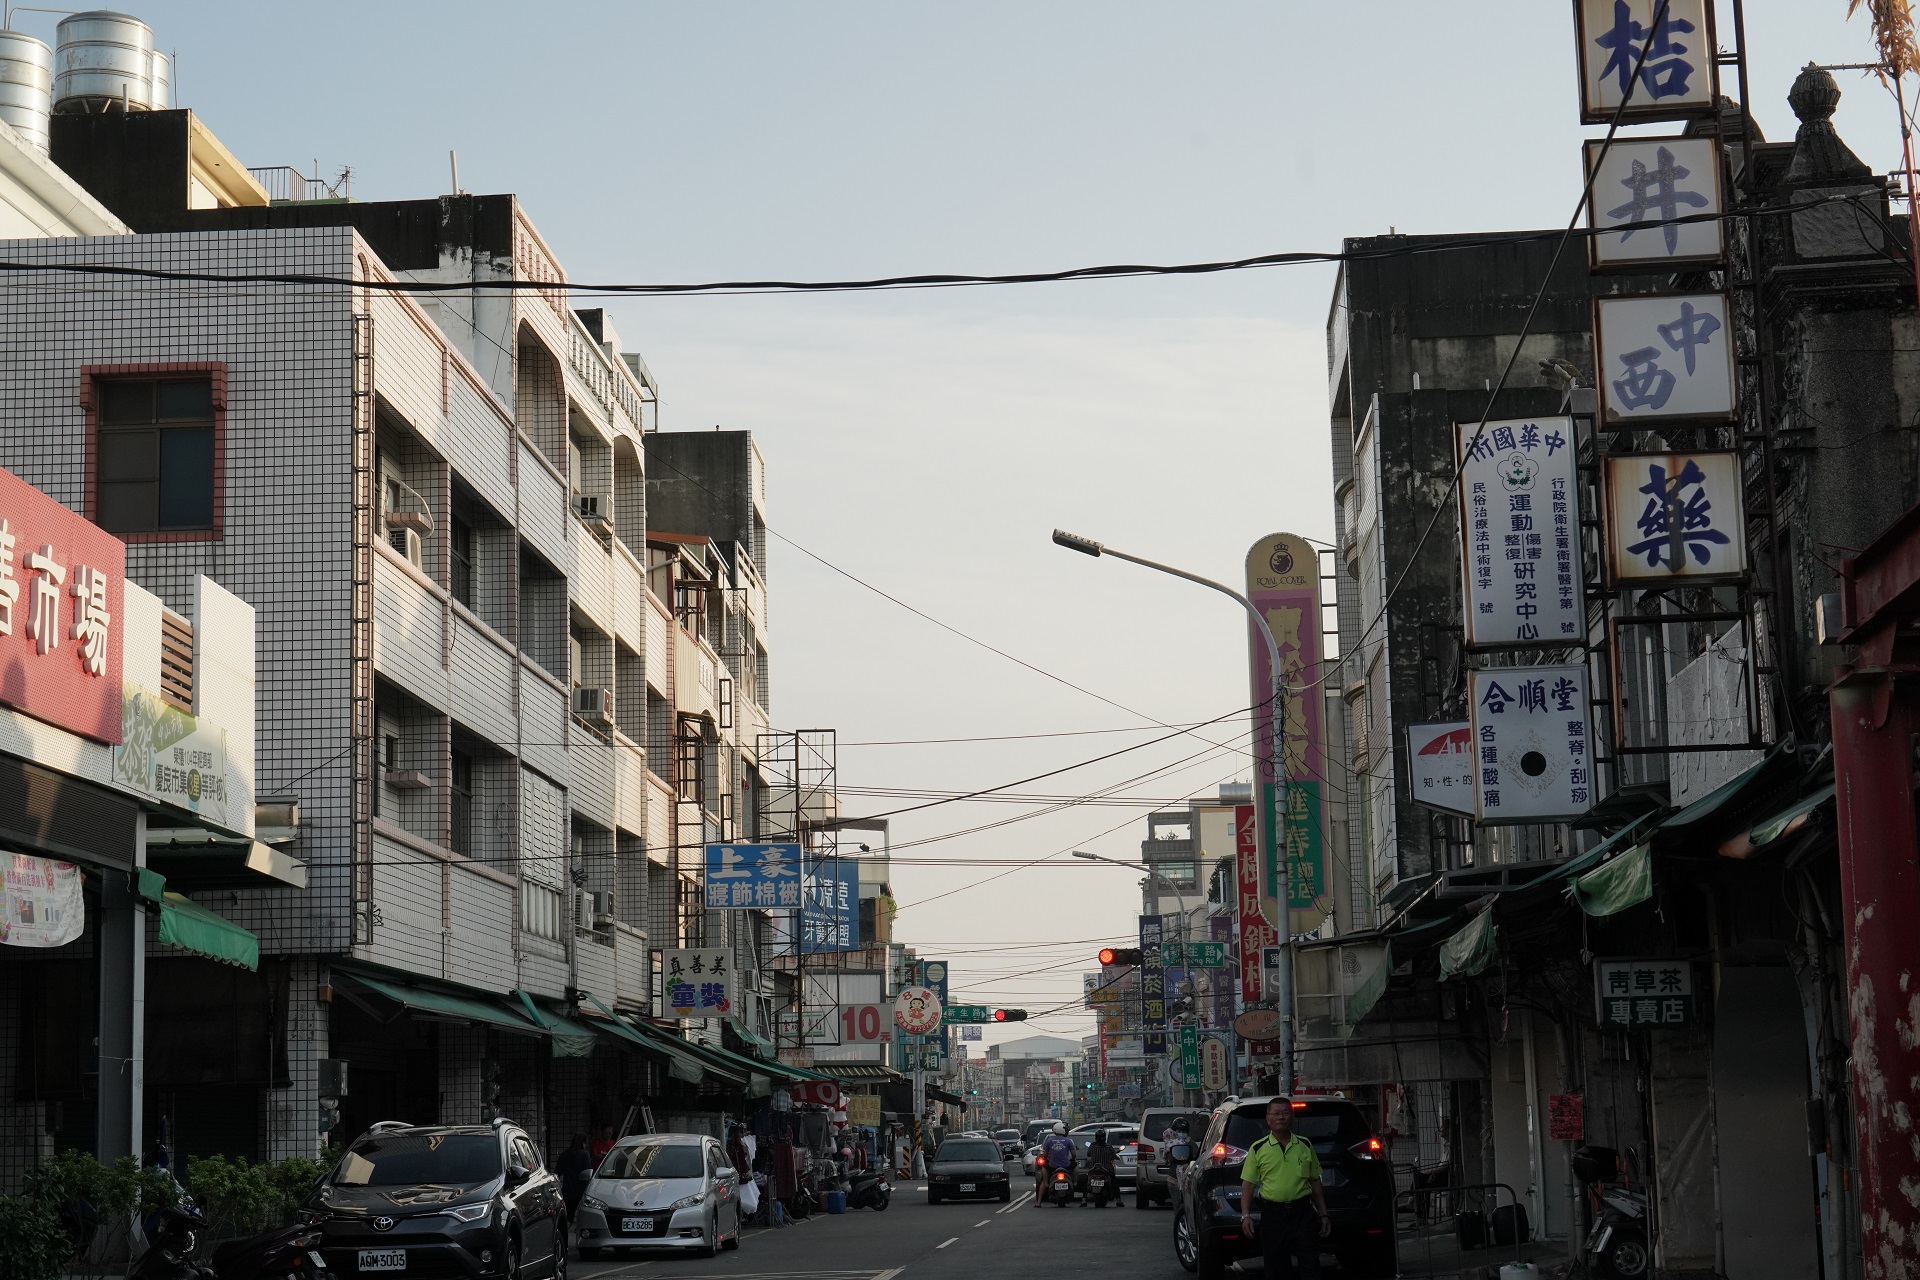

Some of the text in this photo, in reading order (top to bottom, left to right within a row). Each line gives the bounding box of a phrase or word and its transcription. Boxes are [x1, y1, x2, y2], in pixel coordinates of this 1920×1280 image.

[1607, 145, 1709, 256] 井
[1626, 459, 1730, 573] 藥
[1472, 482, 1492, 589] 民俗治療法中術復字
[1257, 577, 1280, 587] ROYAL
[1513, 562, 1539, 640] 研究中心
[1480, 725, 1500, 807] 各種酸痛
[708, 847, 800, 879] 上豪
[804, 919, 850, 947] 牙醫聯盟
[1170, 945, 1216, 956] 新生路
[669, 954, 727, 977] 真善美
[670, 982, 725, 1008] 童裝
[1608, 968, 1683, 995] 青草茶
[947, 1008, 981, 1017] 新生路
[1610, 1000, 1684, 1024] 專賣店
[1184, 1036, 1197, 1083] 中山路
[793, 1082, 838, 1104] 10
[360, 1254, 405, 1267] AQM-3003
